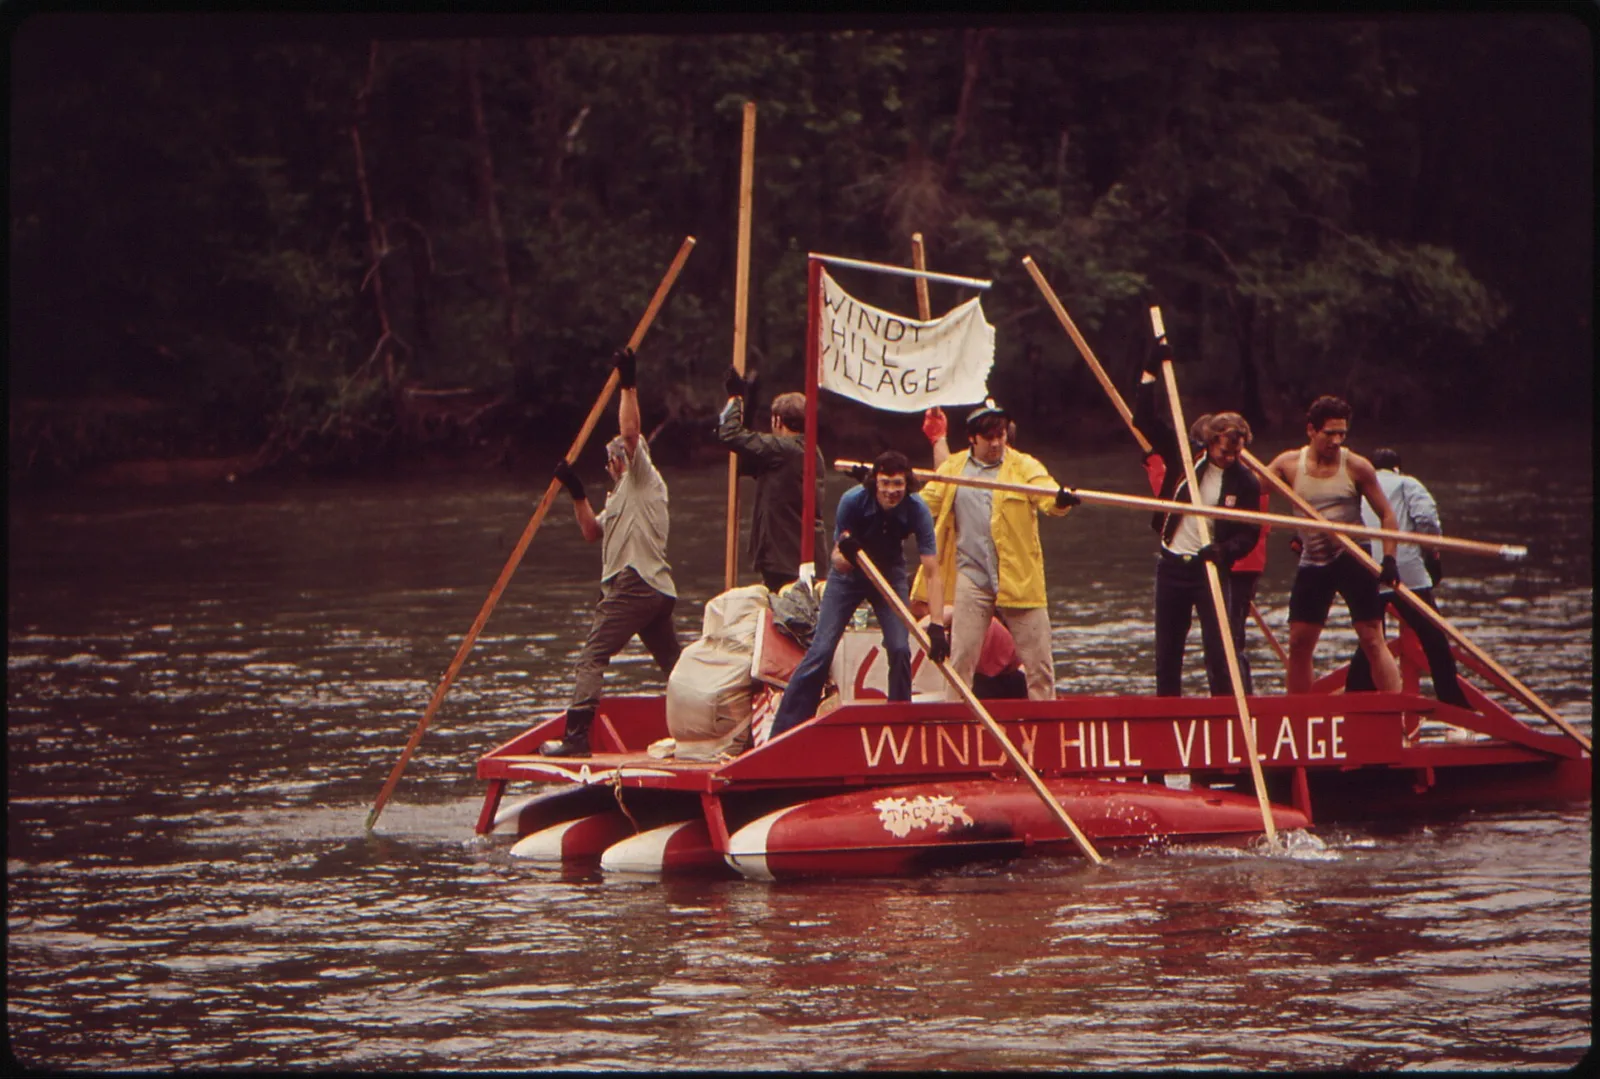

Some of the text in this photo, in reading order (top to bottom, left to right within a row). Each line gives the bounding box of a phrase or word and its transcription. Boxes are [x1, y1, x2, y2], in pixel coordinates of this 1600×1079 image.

[831, 318, 899, 369] HILL
[860, 716, 1348, 768] WINDY HILL VILLAGE
